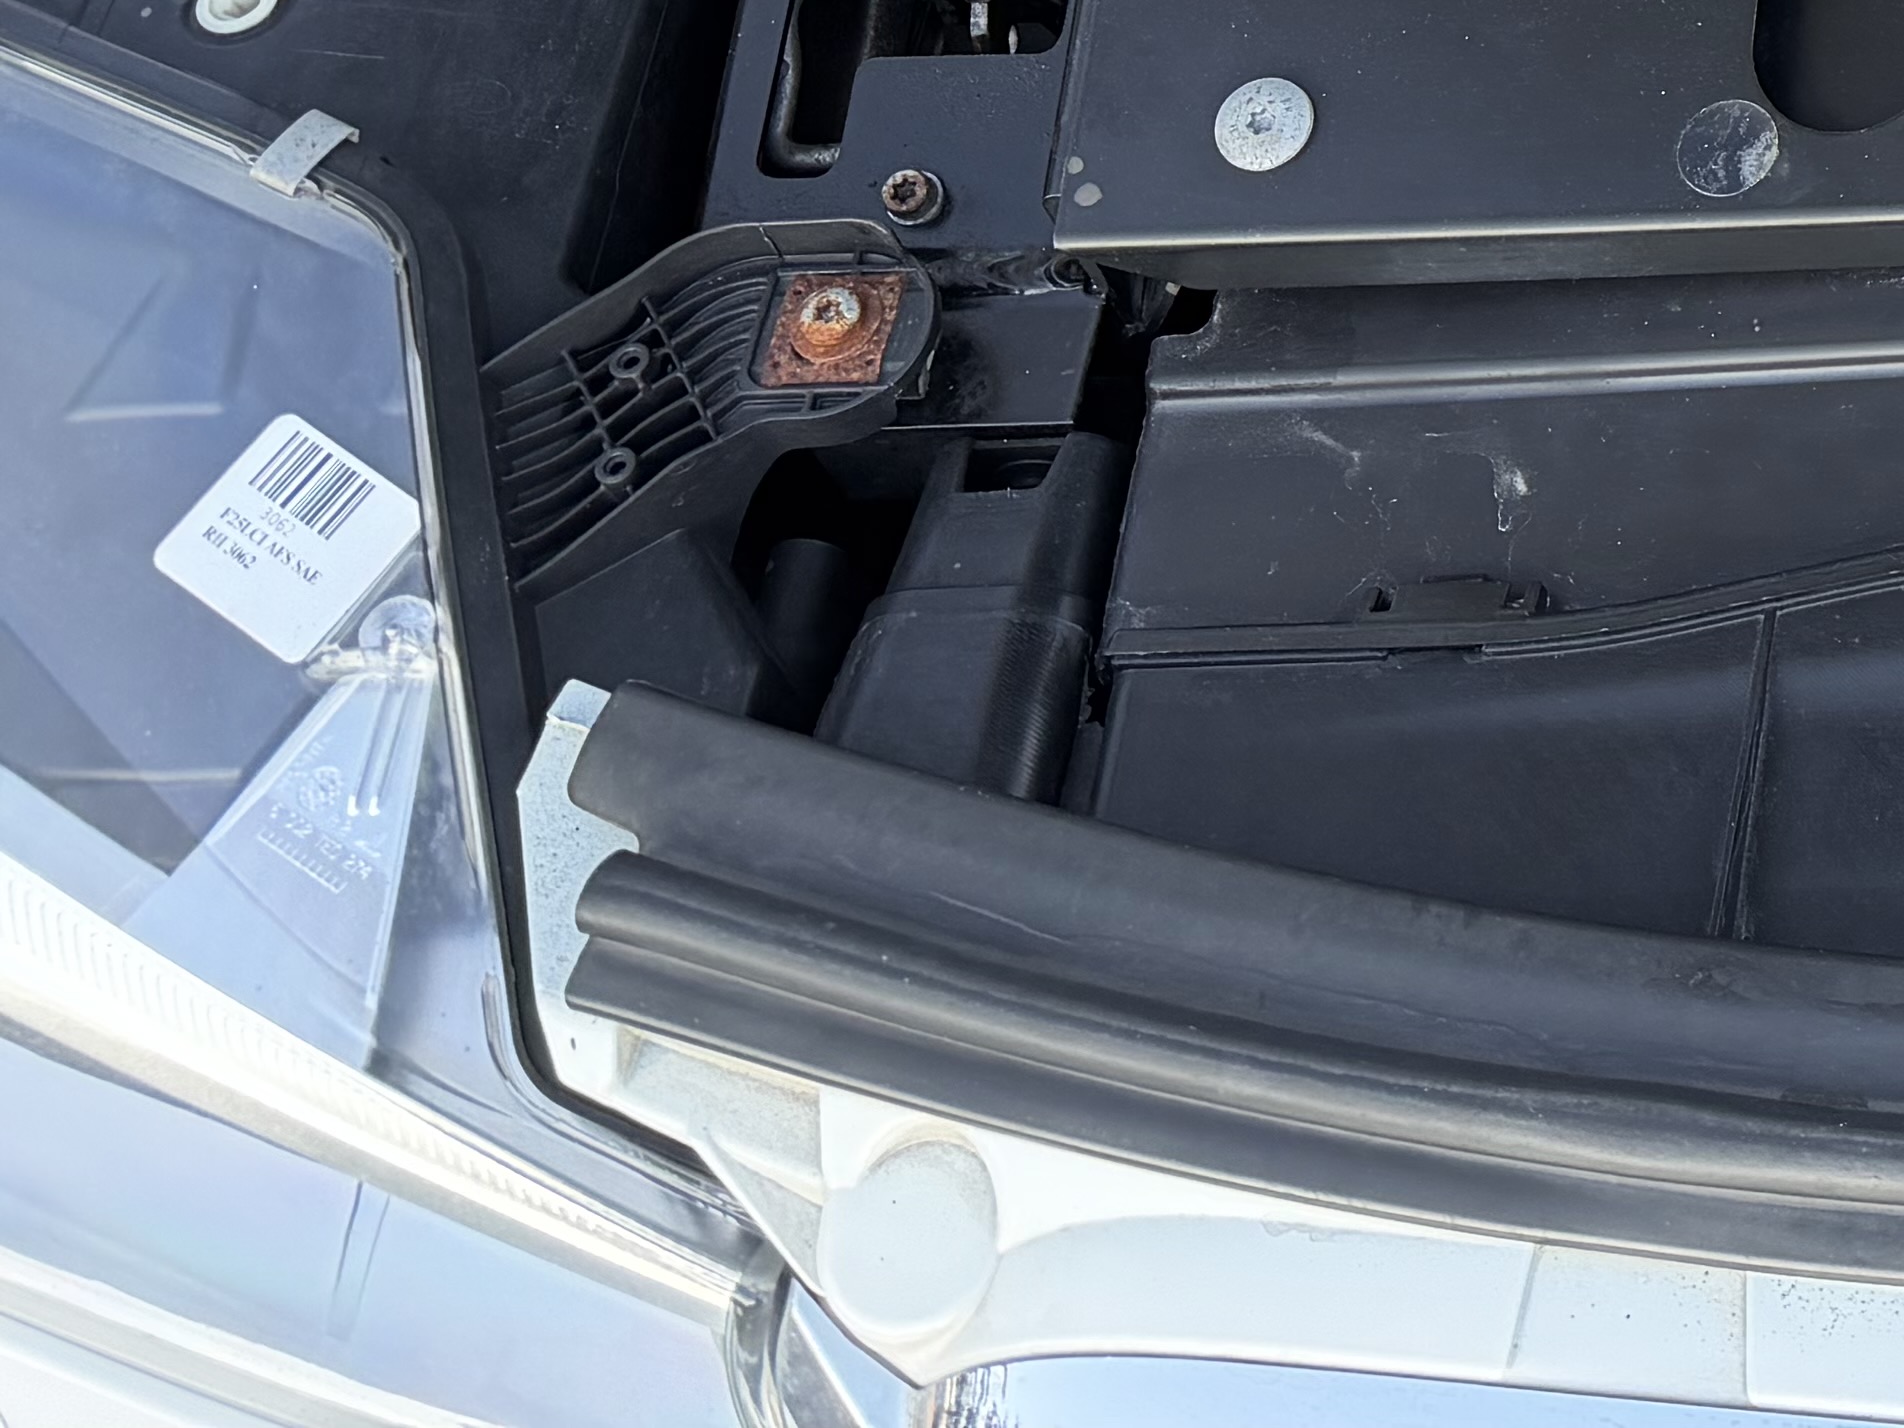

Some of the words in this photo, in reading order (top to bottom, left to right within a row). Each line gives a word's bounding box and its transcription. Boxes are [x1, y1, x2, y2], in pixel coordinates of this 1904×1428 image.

[258, 506, 297, 538] 3062
[218, 506, 269, 547] F25LCI
[265, 540, 297, 567] AFS
[289, 556, 324, 587] SAE
[222, 543, 259, 571] 3062
